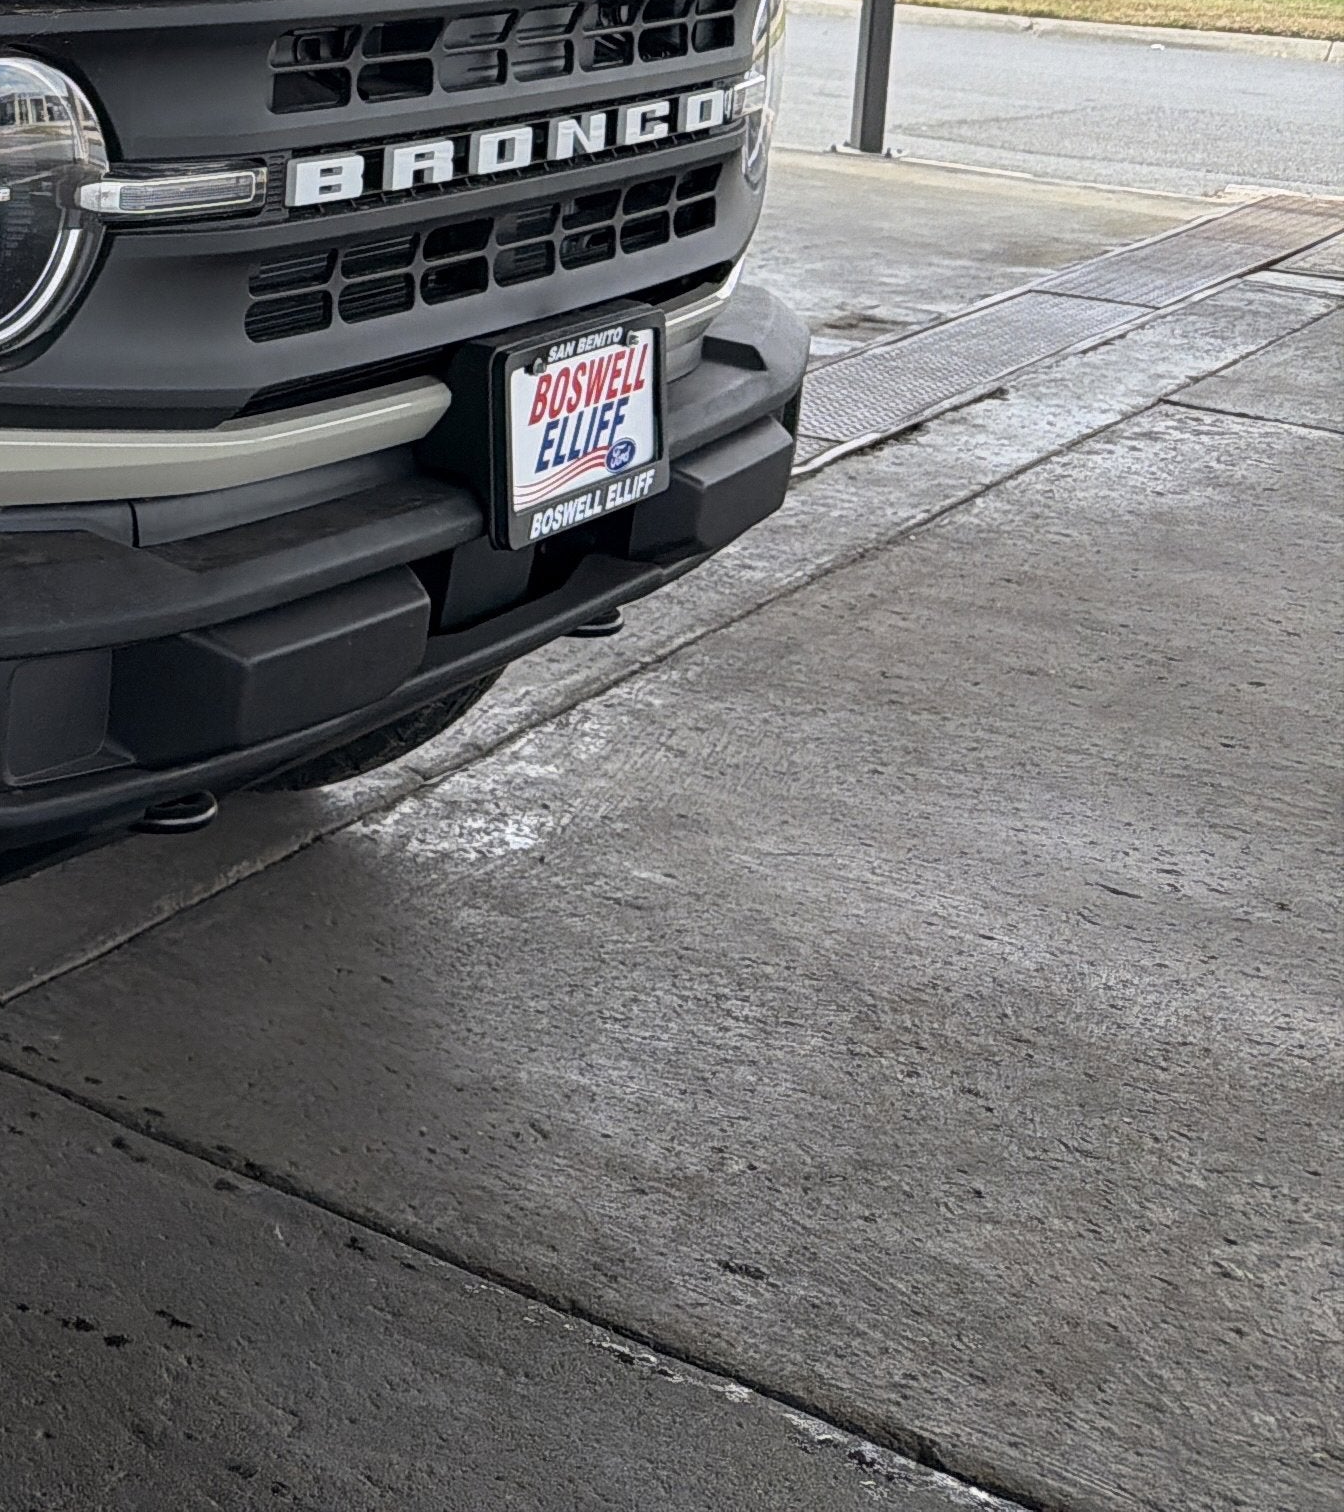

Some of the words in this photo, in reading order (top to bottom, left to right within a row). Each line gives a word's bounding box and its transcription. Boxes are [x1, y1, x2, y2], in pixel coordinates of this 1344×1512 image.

[286, 89, 726, 207] BRONCO
[547, 340, 576, 362] SAN
[576, 326, 623, 353] BENITO
[528, 343, 649, 427] BOSWELL
[534, 396, 630, 474] ELLIFF
[609, 442, 633, 470] Ford
[529, 489, 602, 541] BOSWELL
[605, 469, 656, 507] ELLIFF
